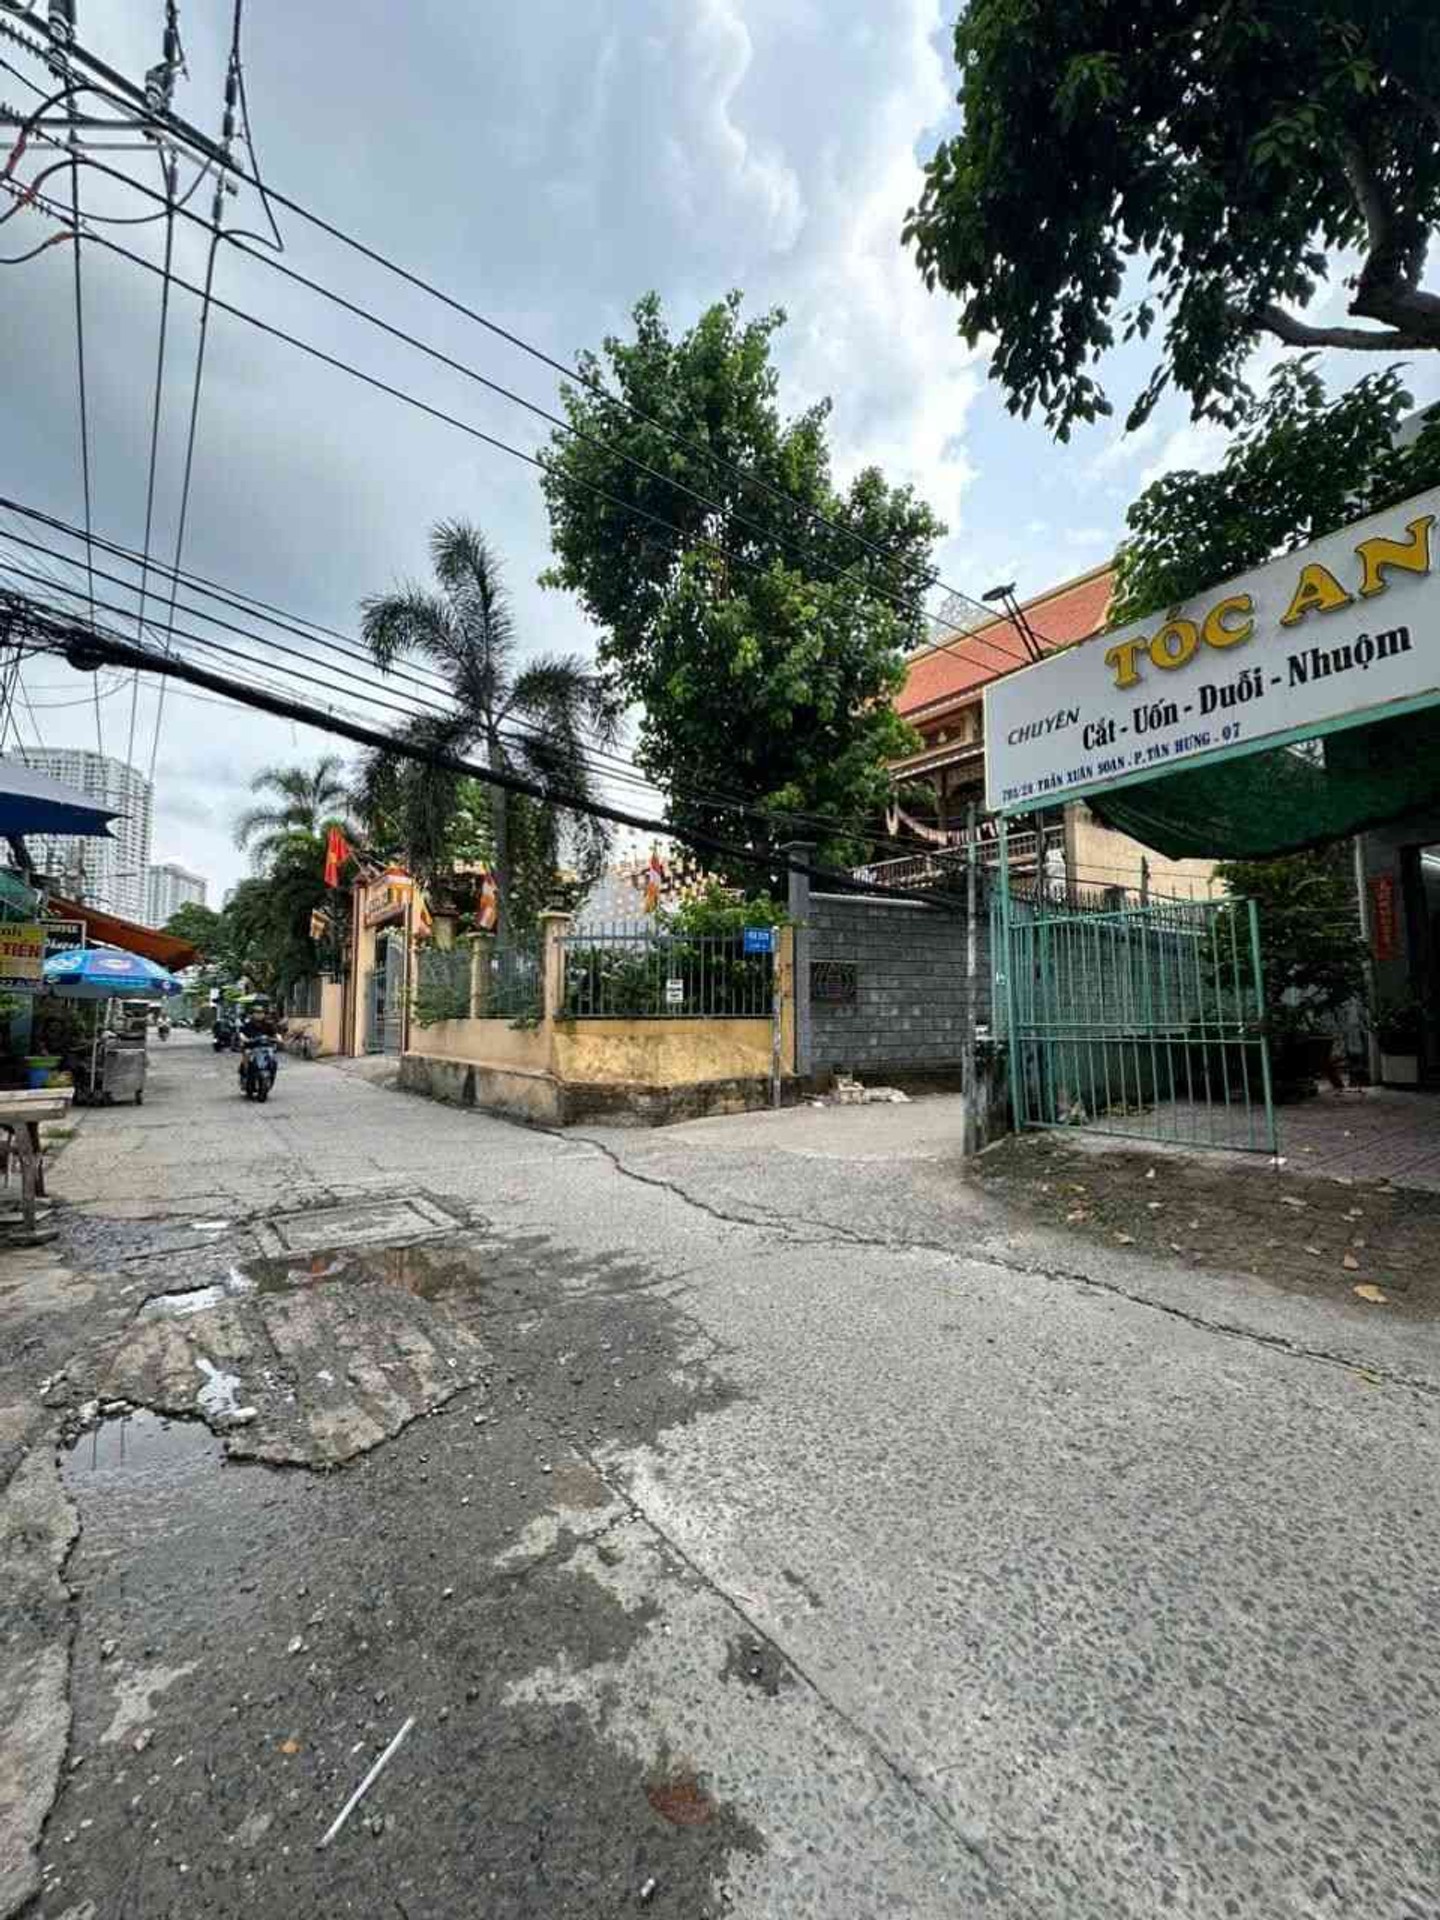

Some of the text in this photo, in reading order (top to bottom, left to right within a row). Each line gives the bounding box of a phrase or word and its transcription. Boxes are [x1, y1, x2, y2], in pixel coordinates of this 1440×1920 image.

[1104, 514, 1436, 690] TÓC AN
[1083, 716, 1115, 750] Cắt
[1133, 698, 1179, 734] Uốn
[1287, 625, 1413, 688] Nhuộm
